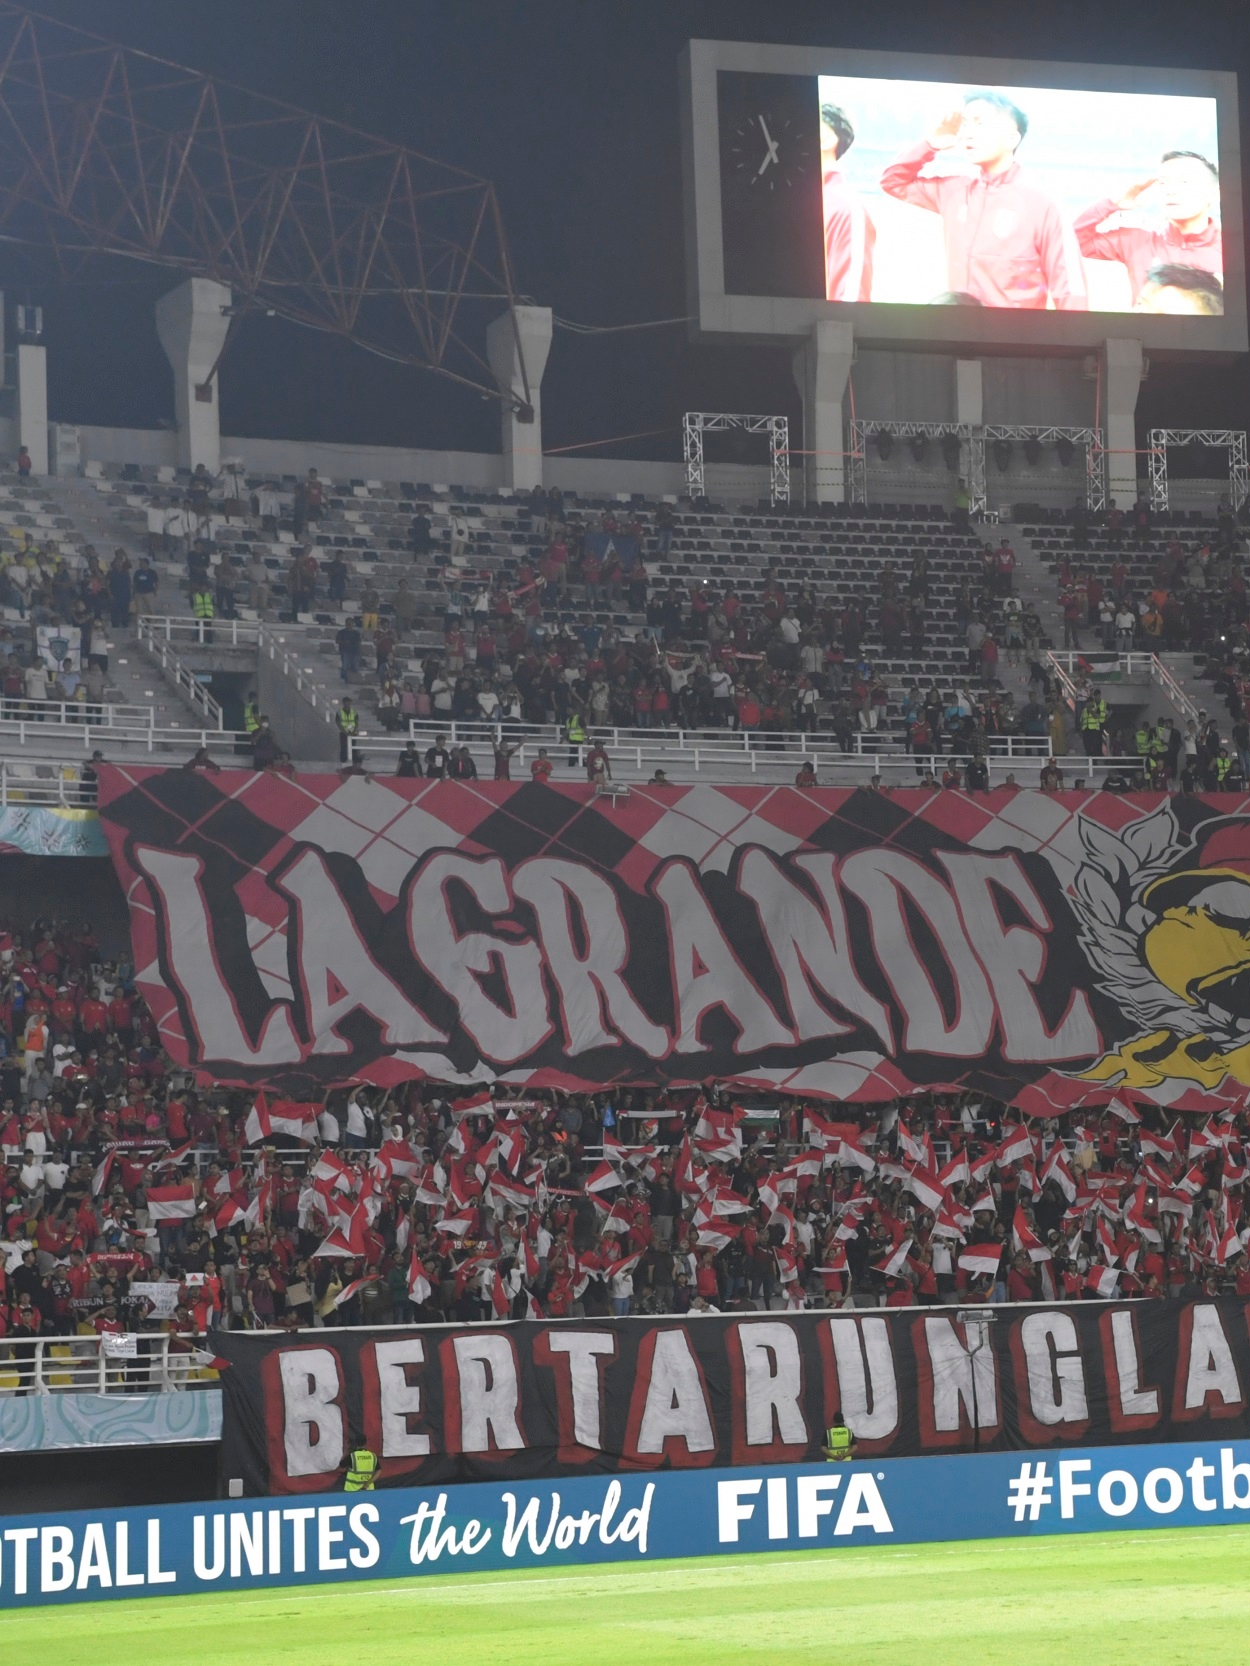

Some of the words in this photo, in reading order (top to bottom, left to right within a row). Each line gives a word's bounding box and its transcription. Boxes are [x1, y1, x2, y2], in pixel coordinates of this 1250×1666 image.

[0, 1519, 176, 1597] TBALL
[193, 1503, 380, 1580] UNITES
[400, 1493, 492, 1565] the
[501, 1480, 656, 1558] World
